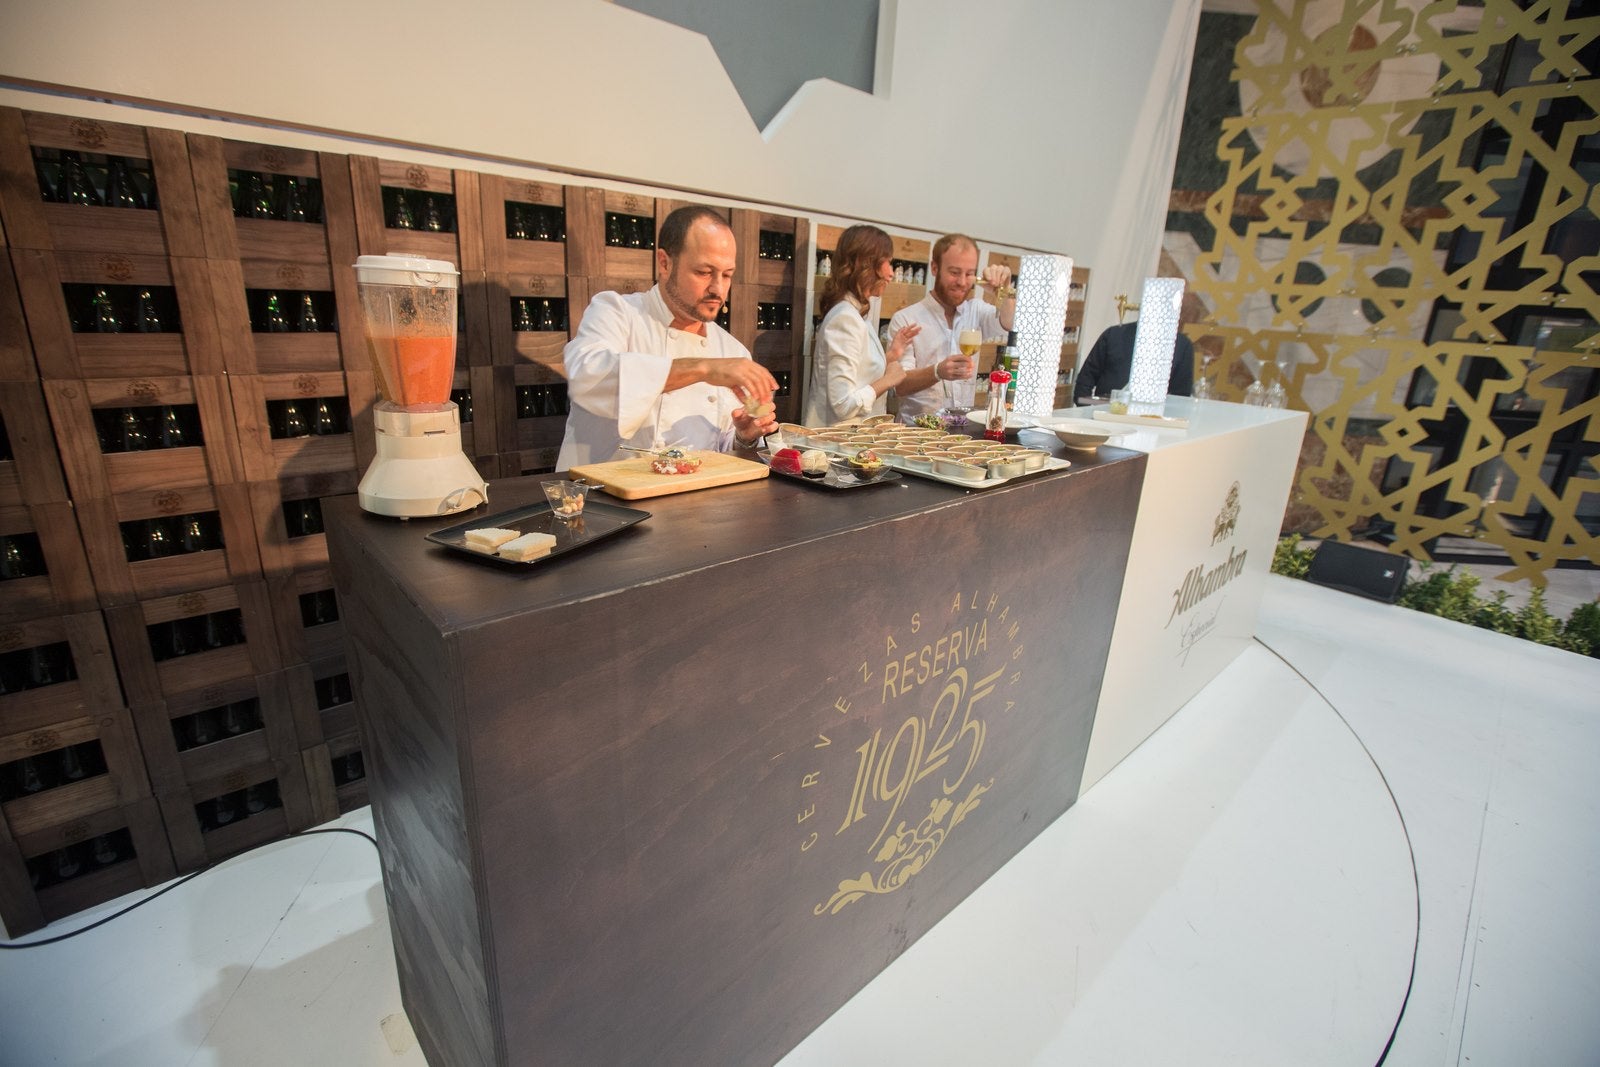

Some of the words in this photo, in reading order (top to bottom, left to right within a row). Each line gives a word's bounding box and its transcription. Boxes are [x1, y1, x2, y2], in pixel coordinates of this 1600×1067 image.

[1164, 546, 1248, 630] Alhambra
[797, 612, 921, 852] CERVEZAS
[951, 590, 1024, 712] ALHAMBRA
[882, 618, 988, 704] RESERVA
[835, 662, 1007, 853] 1925
